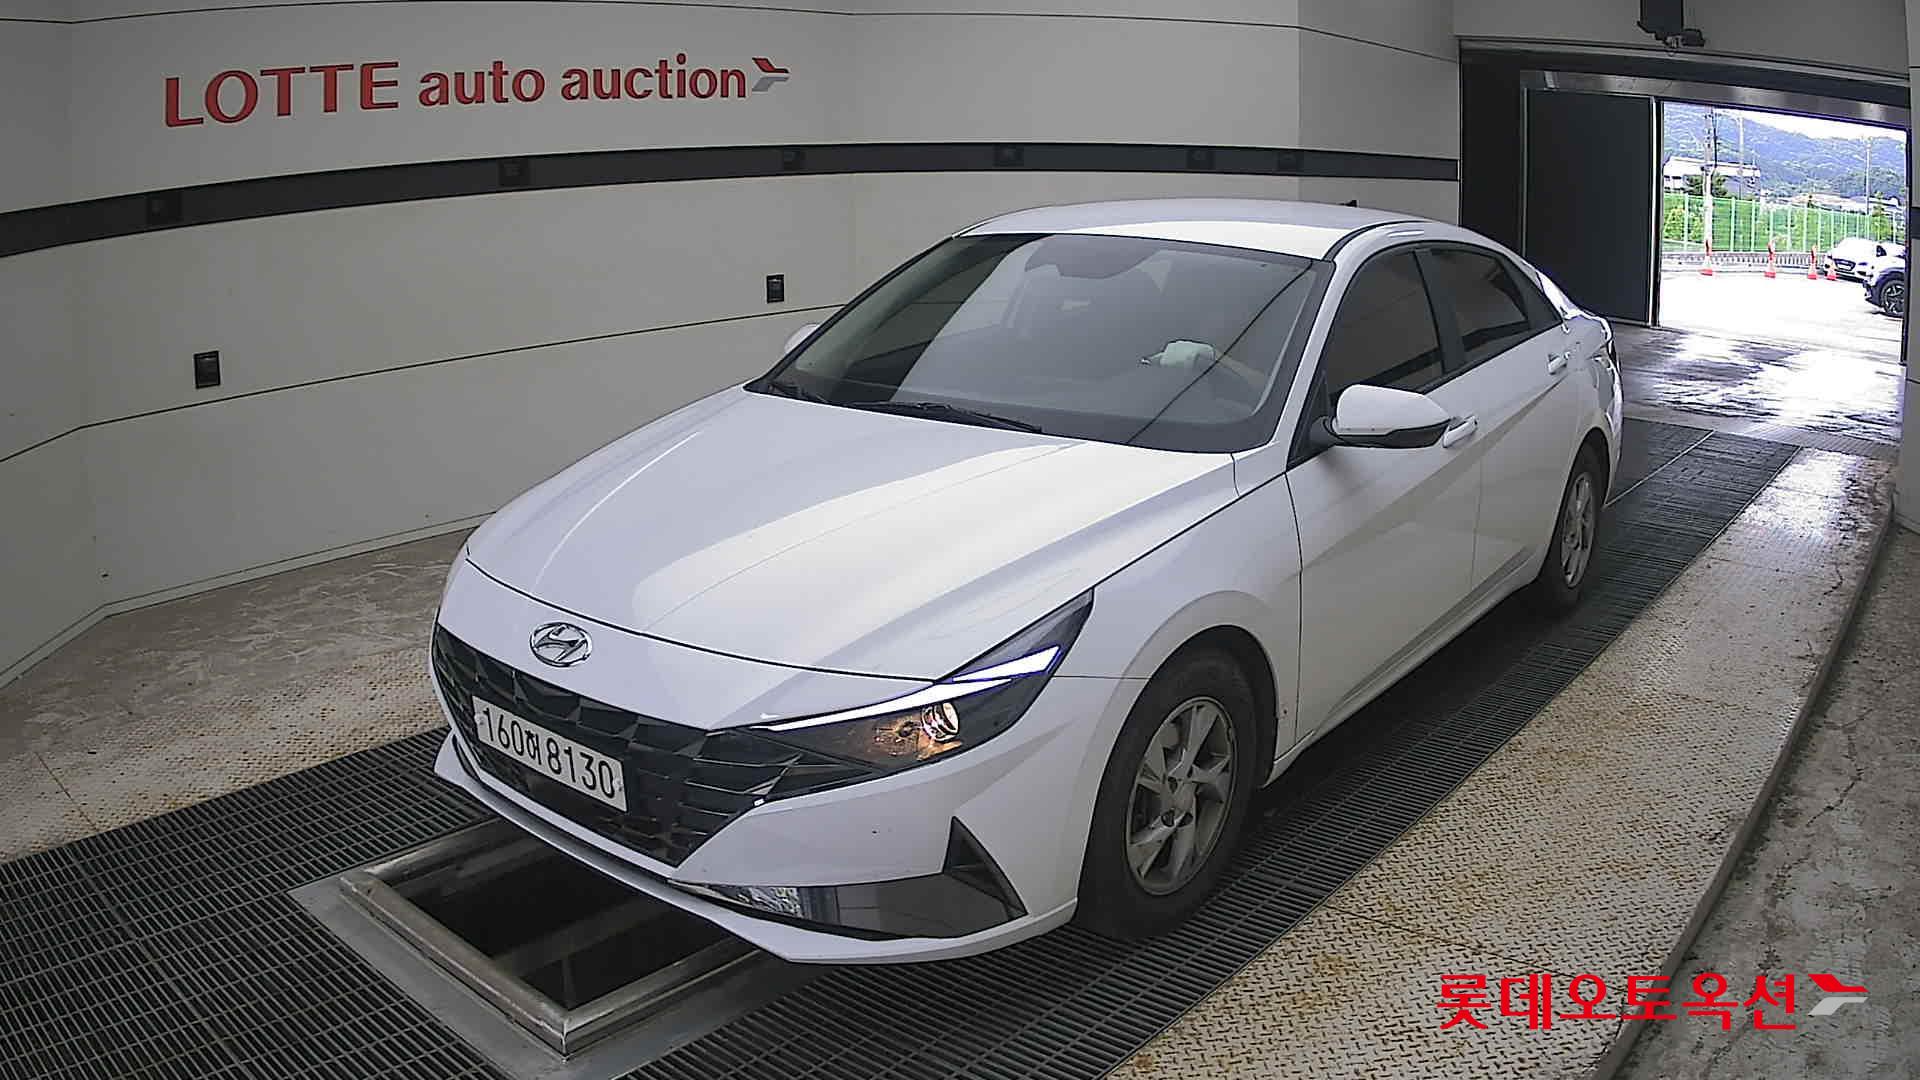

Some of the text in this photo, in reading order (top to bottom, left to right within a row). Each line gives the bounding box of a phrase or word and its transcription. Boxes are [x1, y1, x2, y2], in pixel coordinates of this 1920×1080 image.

[165, 52, 747, 127] LOTTE auto auction
